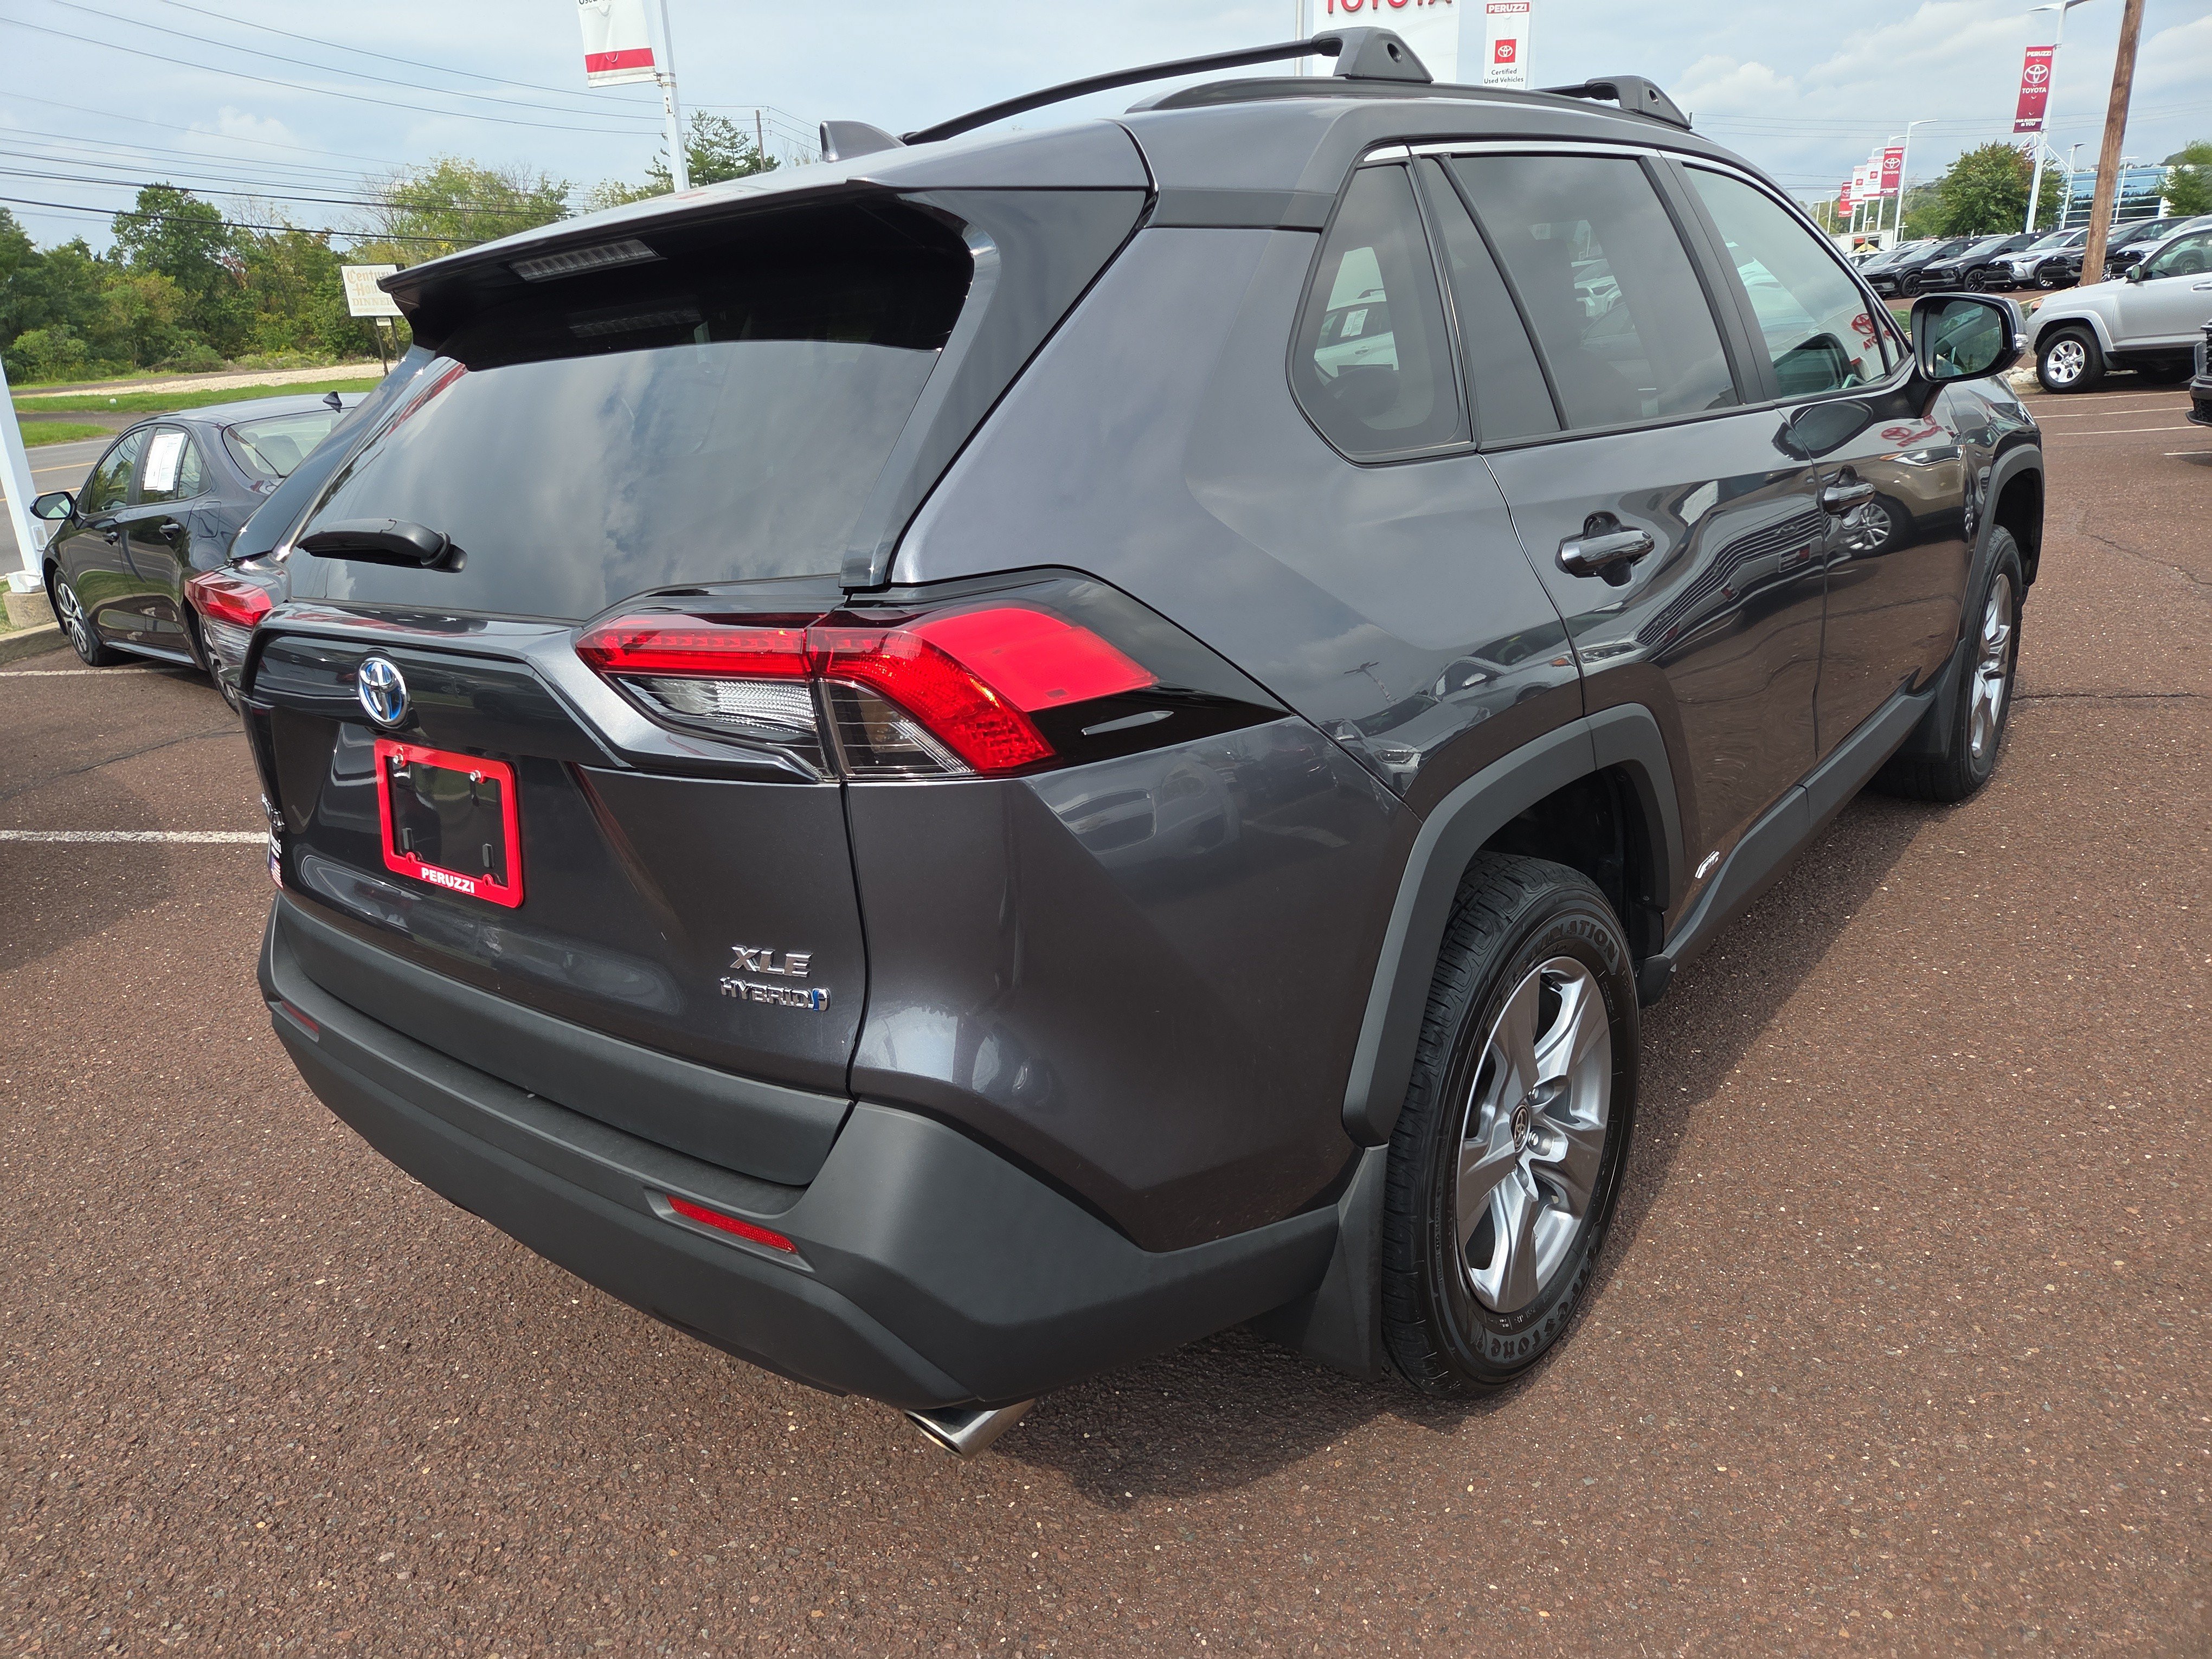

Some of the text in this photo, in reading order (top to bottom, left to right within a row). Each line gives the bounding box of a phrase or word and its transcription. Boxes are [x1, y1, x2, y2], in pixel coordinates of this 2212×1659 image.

[1488, 3, 1527, 12] PERUZZI
[352, 282, 382, 297] Hou
[421, 867, 475, 894] PERUZZI
[730, 945, 813, 978] XLE
[720, 976, 814, 1009] HYBRID
